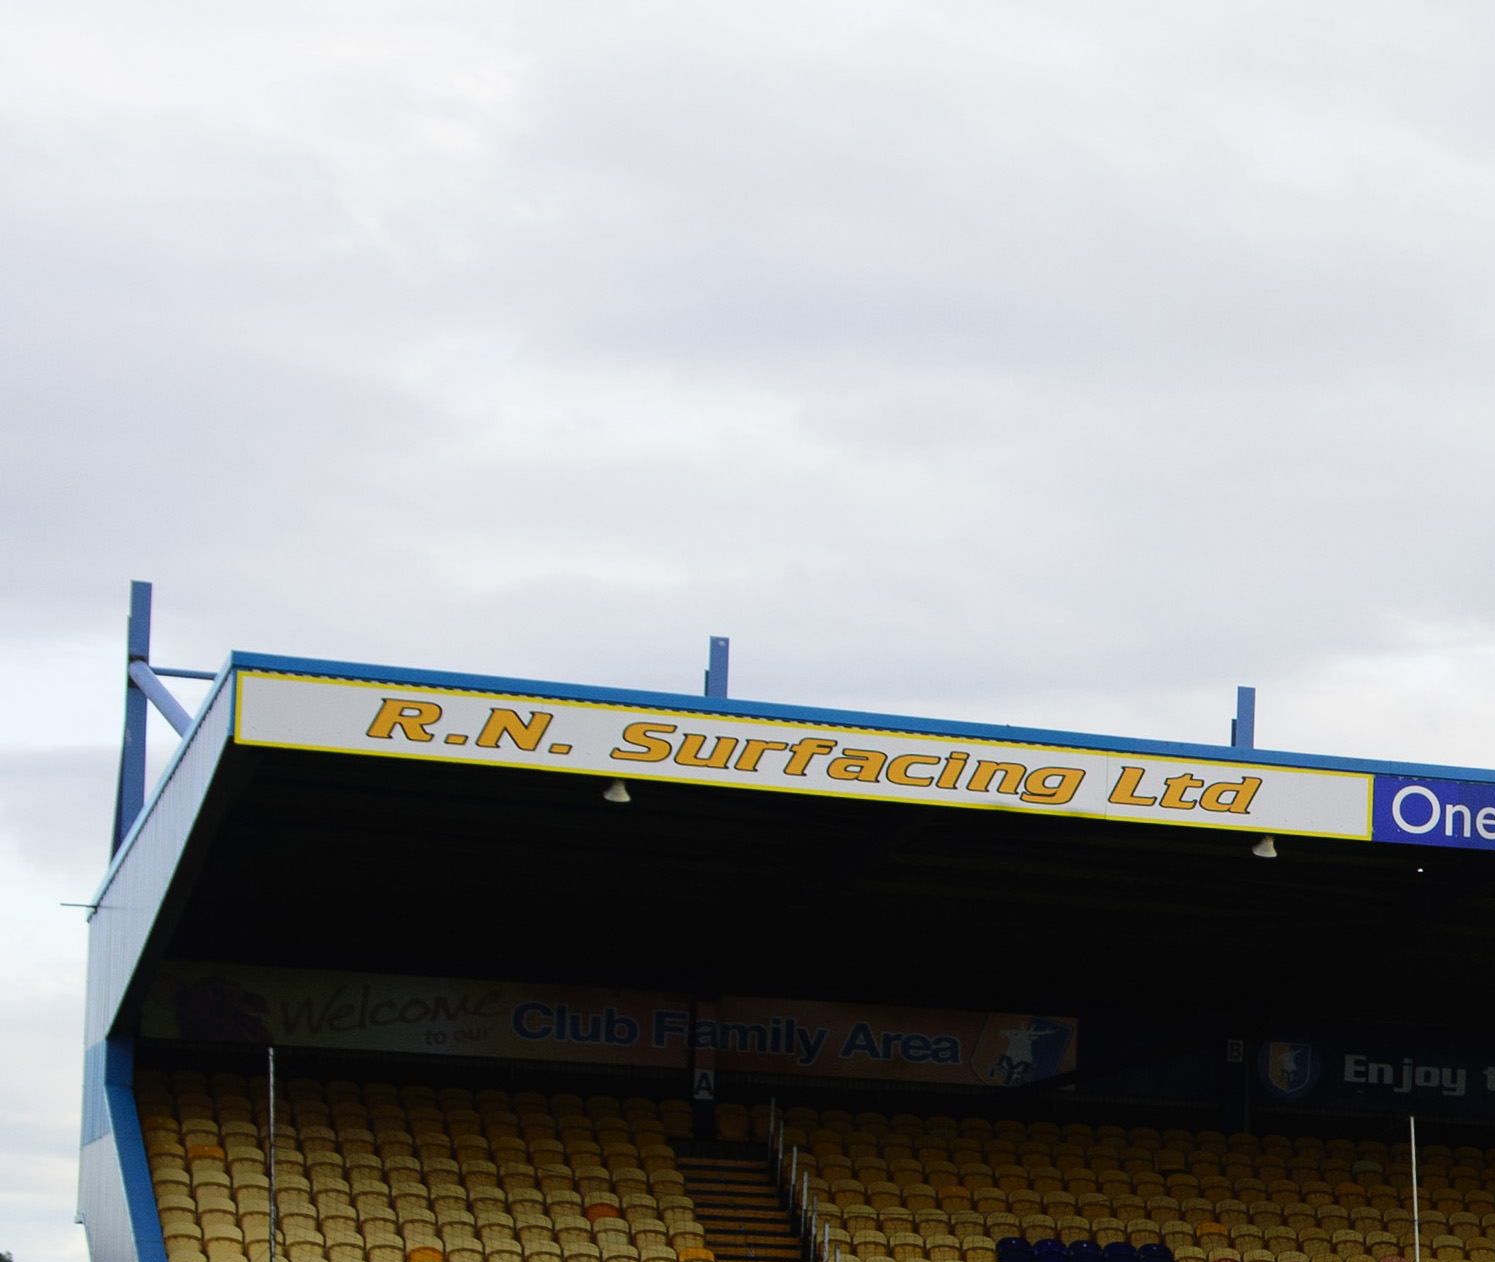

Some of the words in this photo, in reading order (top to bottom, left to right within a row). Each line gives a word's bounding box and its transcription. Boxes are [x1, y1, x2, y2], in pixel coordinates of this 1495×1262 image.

[366, 698, 573, 754] R.N.
[610, 722, 1086, 805] Surfacing
[1107, 766, 1262, 814] Ltd
[511, 1001, 638, 1047] Club
[652, 1009, 828, 1065] Family
[840, 1021, 962, 1065] Area
[1344, 1054, 1467, 1096] Enjoy
